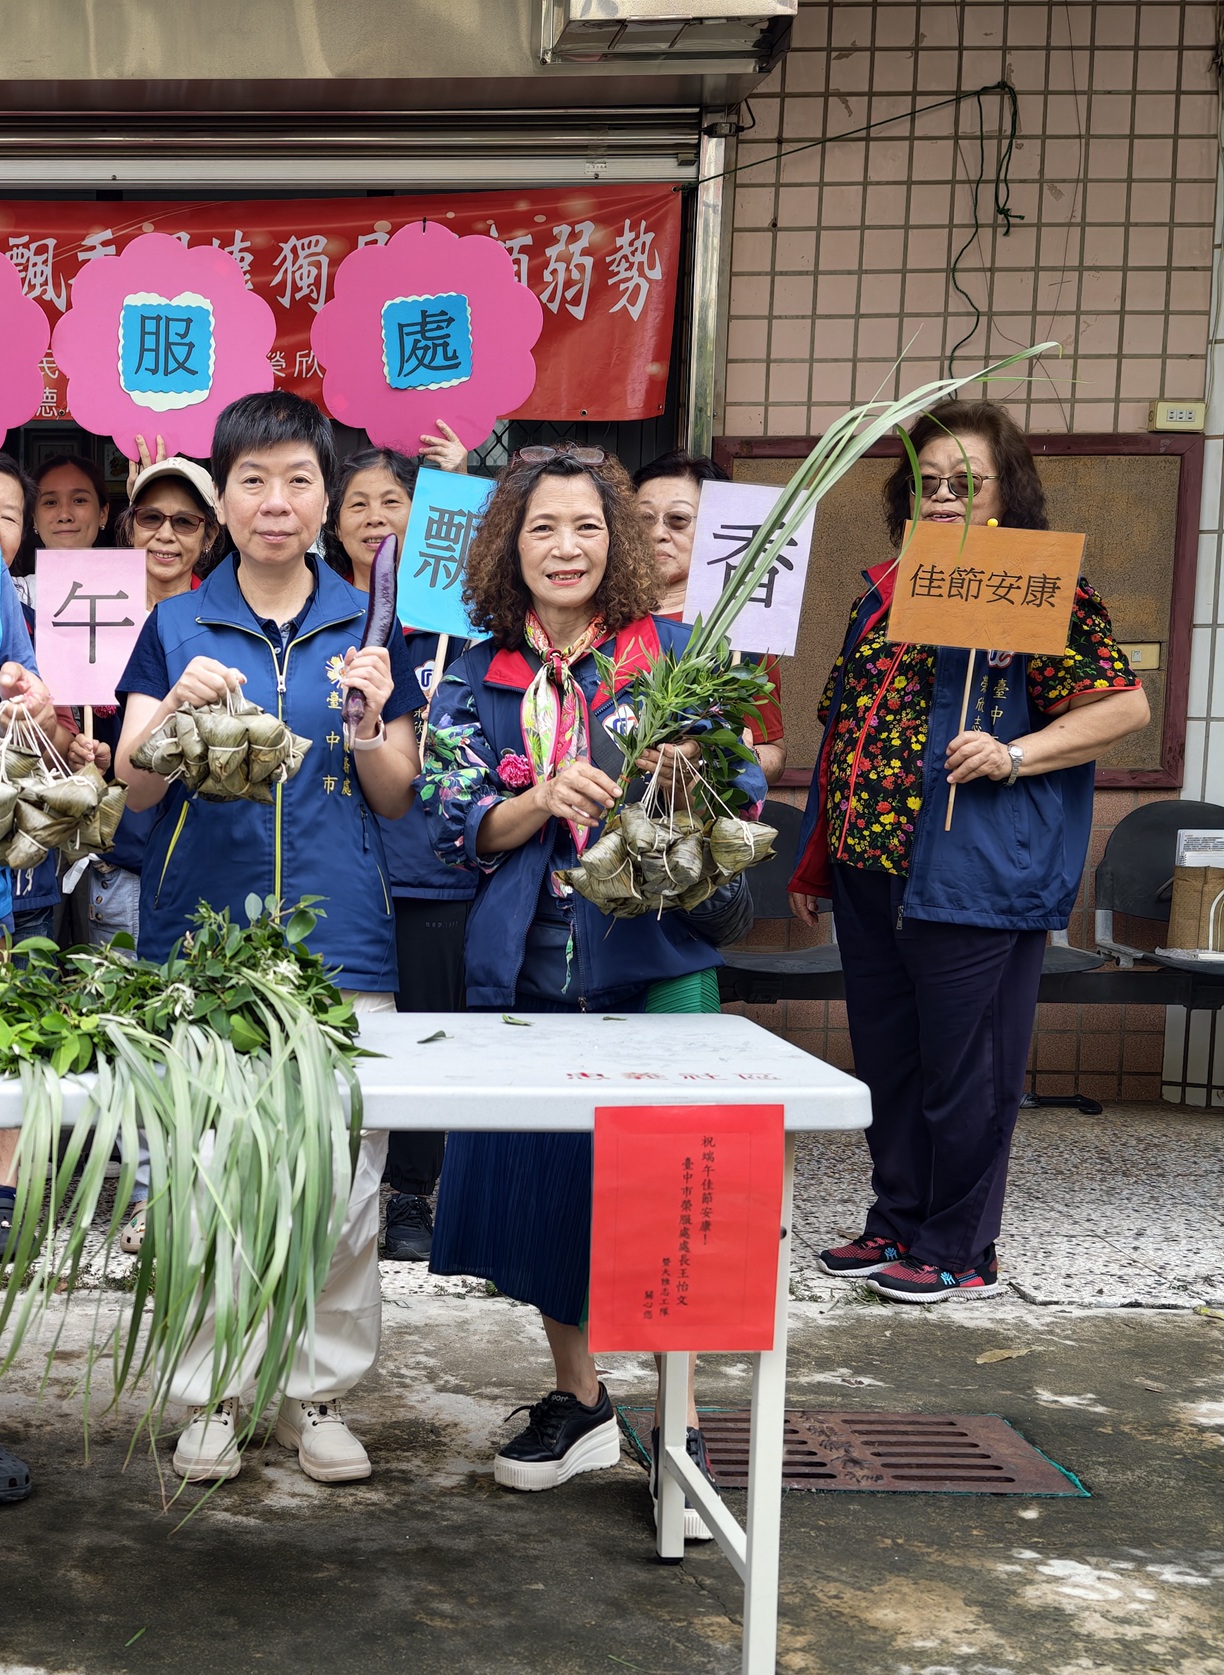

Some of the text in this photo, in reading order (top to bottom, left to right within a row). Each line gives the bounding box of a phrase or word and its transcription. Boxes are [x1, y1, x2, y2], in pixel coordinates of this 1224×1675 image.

[134, 313, 199, 376] 服
[397, 309, 462, 379] 處
[706, 521, 798, 609] 香
[909, 563, 1063, 608] 佳節安康
[51, 580, 136, 664] 午
[322, 690, 343, 795] 臺中市
[990, 678, 1010, 739] 臺中
